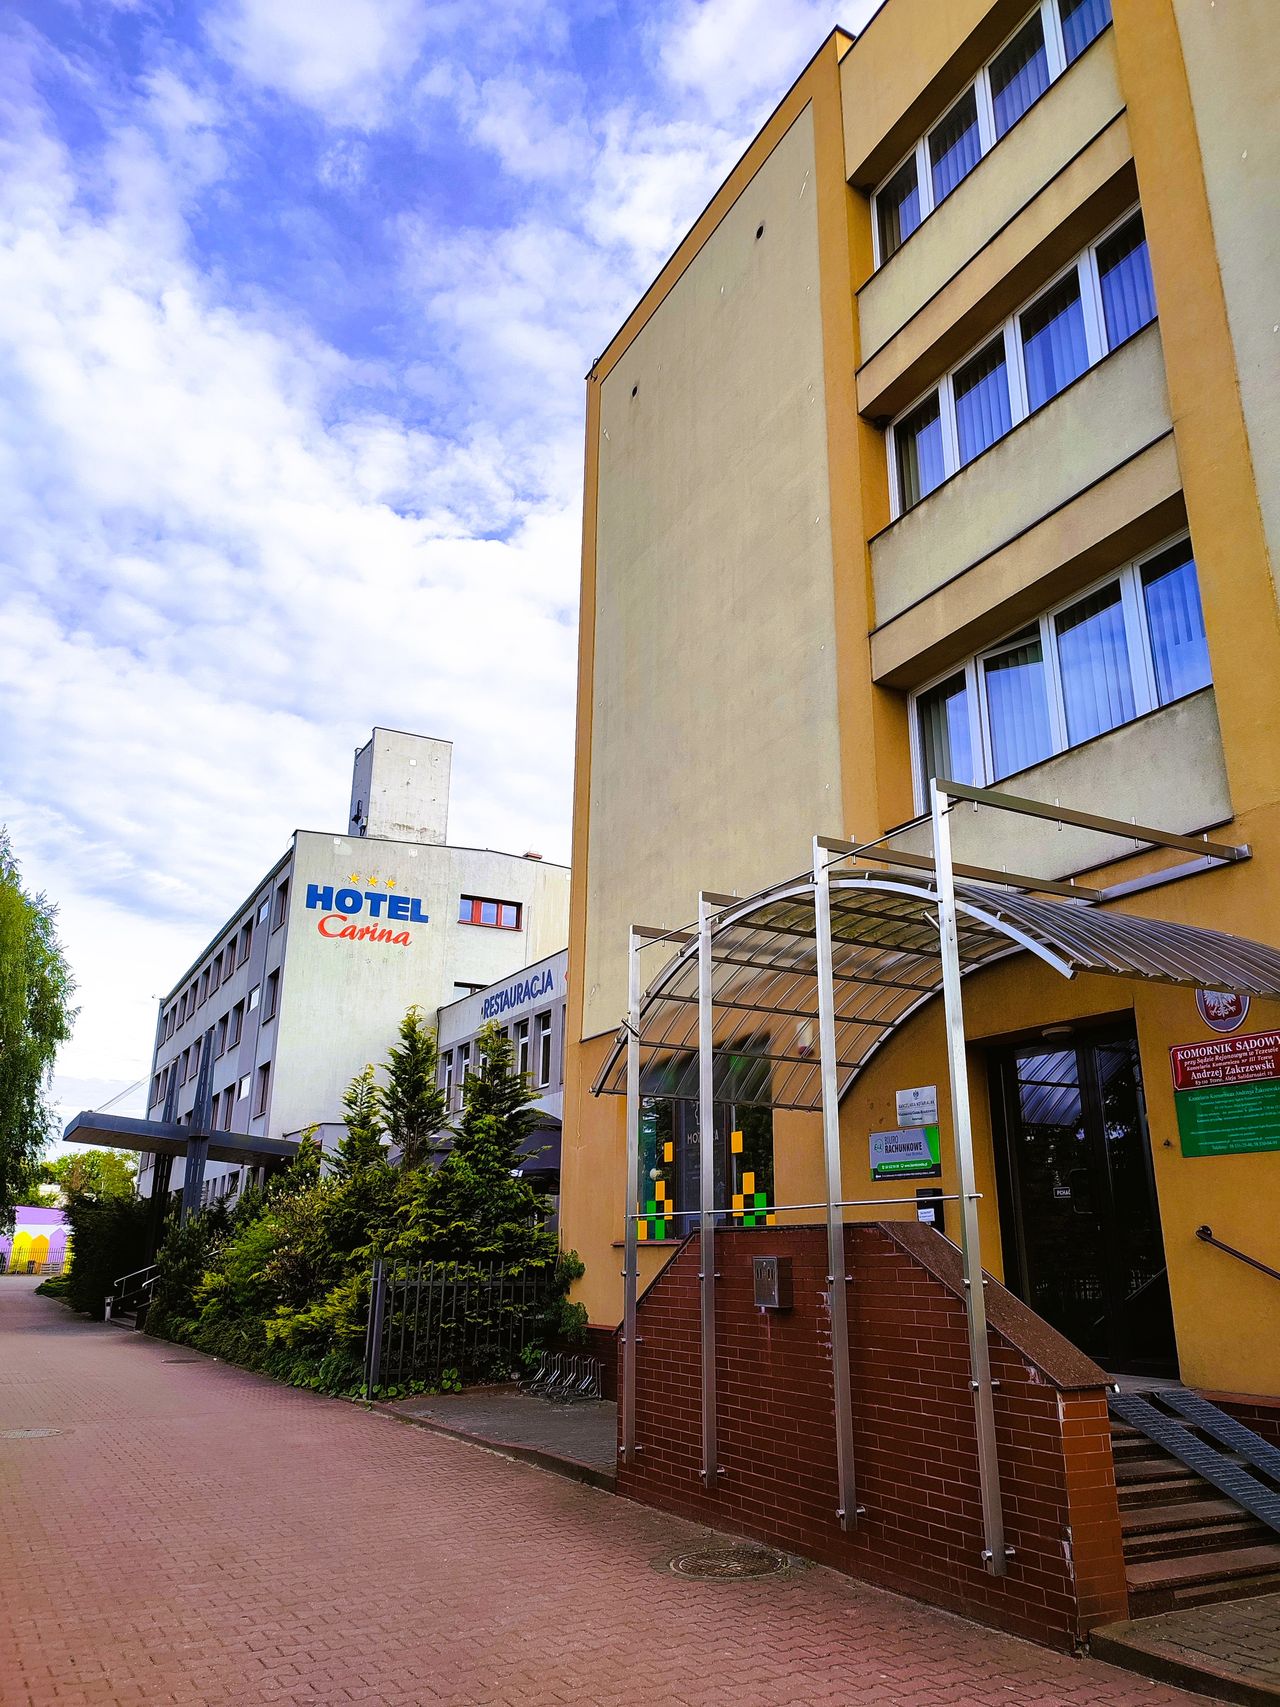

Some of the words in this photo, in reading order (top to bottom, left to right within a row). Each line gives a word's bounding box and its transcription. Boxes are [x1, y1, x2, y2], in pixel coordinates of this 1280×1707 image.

[305, 883, 429, 924] HOTEL
[317, 913, 413, 947] Carina
[483, 968, 554, 1020] RESTAURACJA
[1177, 1043, 1233, 1060] KOMORNIK
[1184, 1059, 1197, 1068] przy
[1191, 1066, 1223, 1080] Andrzej
[1224, 1059, 1276, 1075] Zakrzewski
[884, 1135, 899, 1145] BIURO
[884, 1141, 923, 1154] RACHUNKOWE
